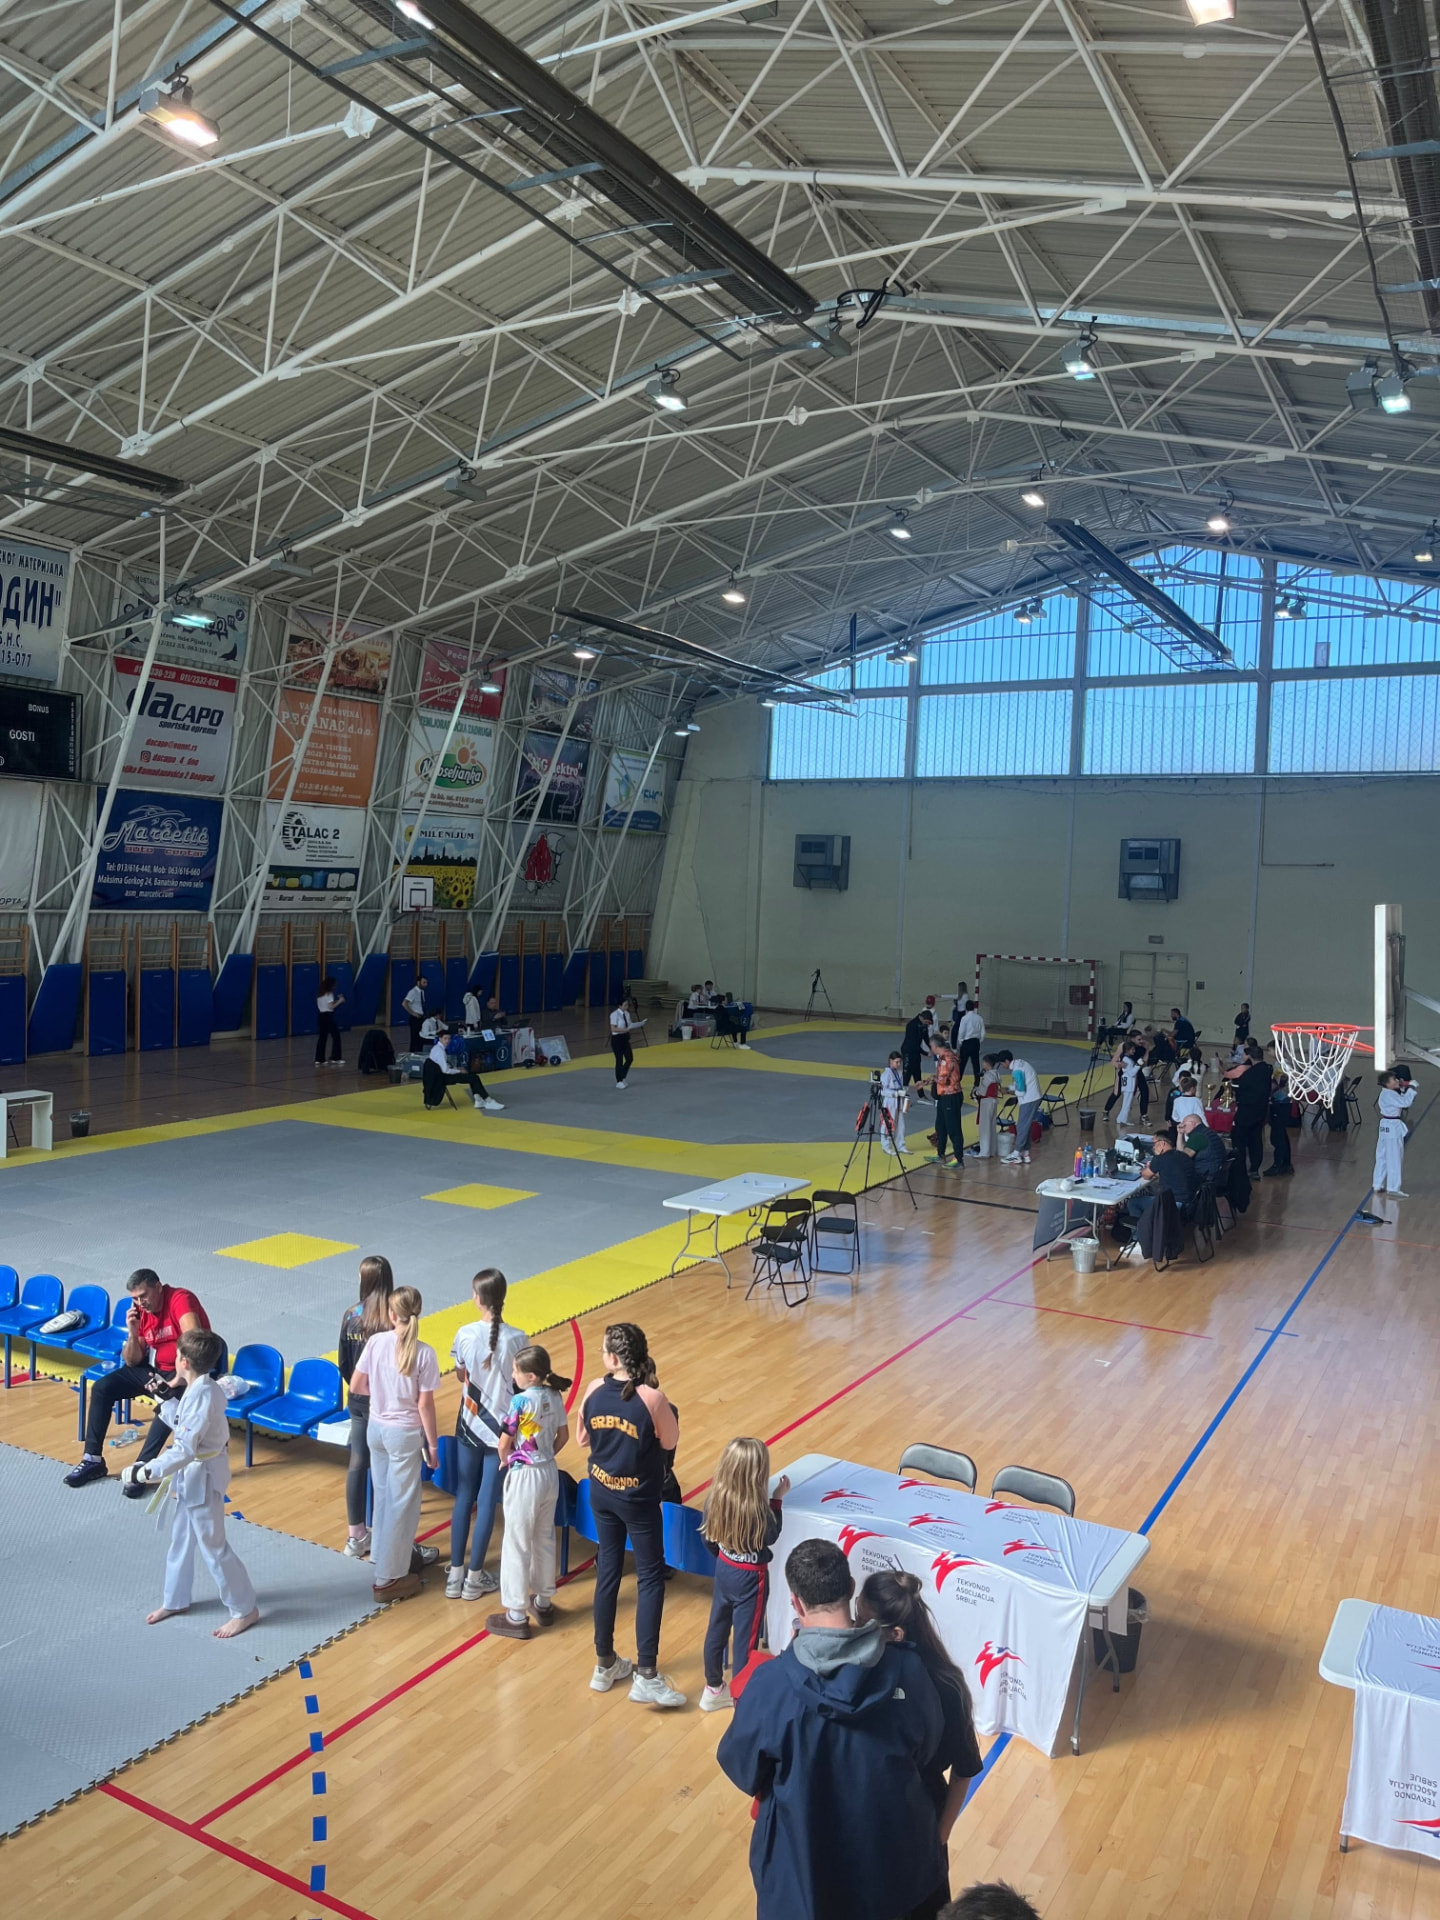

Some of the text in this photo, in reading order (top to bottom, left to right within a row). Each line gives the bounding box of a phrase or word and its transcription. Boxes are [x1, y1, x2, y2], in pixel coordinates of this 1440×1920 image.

[19, 554, 64, 577] МАТЕРИЈАЛА
[28, 703, 50, 714] BONUS
[9, 729, 36, 742] GOSTI
[332, 828, 341, 840] 2
[420, 830, 475, 840] MILENIJUM
[98, 874, 123, 885] Maksima
[123, 876, 145, 888] Gorkog
[153, 877, 179, 887] Banatsko
[179, 880, 193, 888] novo
[590, 1414, 640, 1440] SRBIJA
[591, 1463, 640, 1489] TAEKWONDO
[861, 1548, 894, 1563] TEKVONDO
[956, 1578, 991, 1593] TEKVONDO
[955, 1587, 996, 1604] ASOCIJACIJA
[955, 1595, 978, 1606] SRBIJE
[1388, 1778, 1438, 1798] ASOCIJACIJA
[1409, 1773, 1438, 1788] SRBIJE
[1394, 1790, 1437, 1808] TEKVONDO
